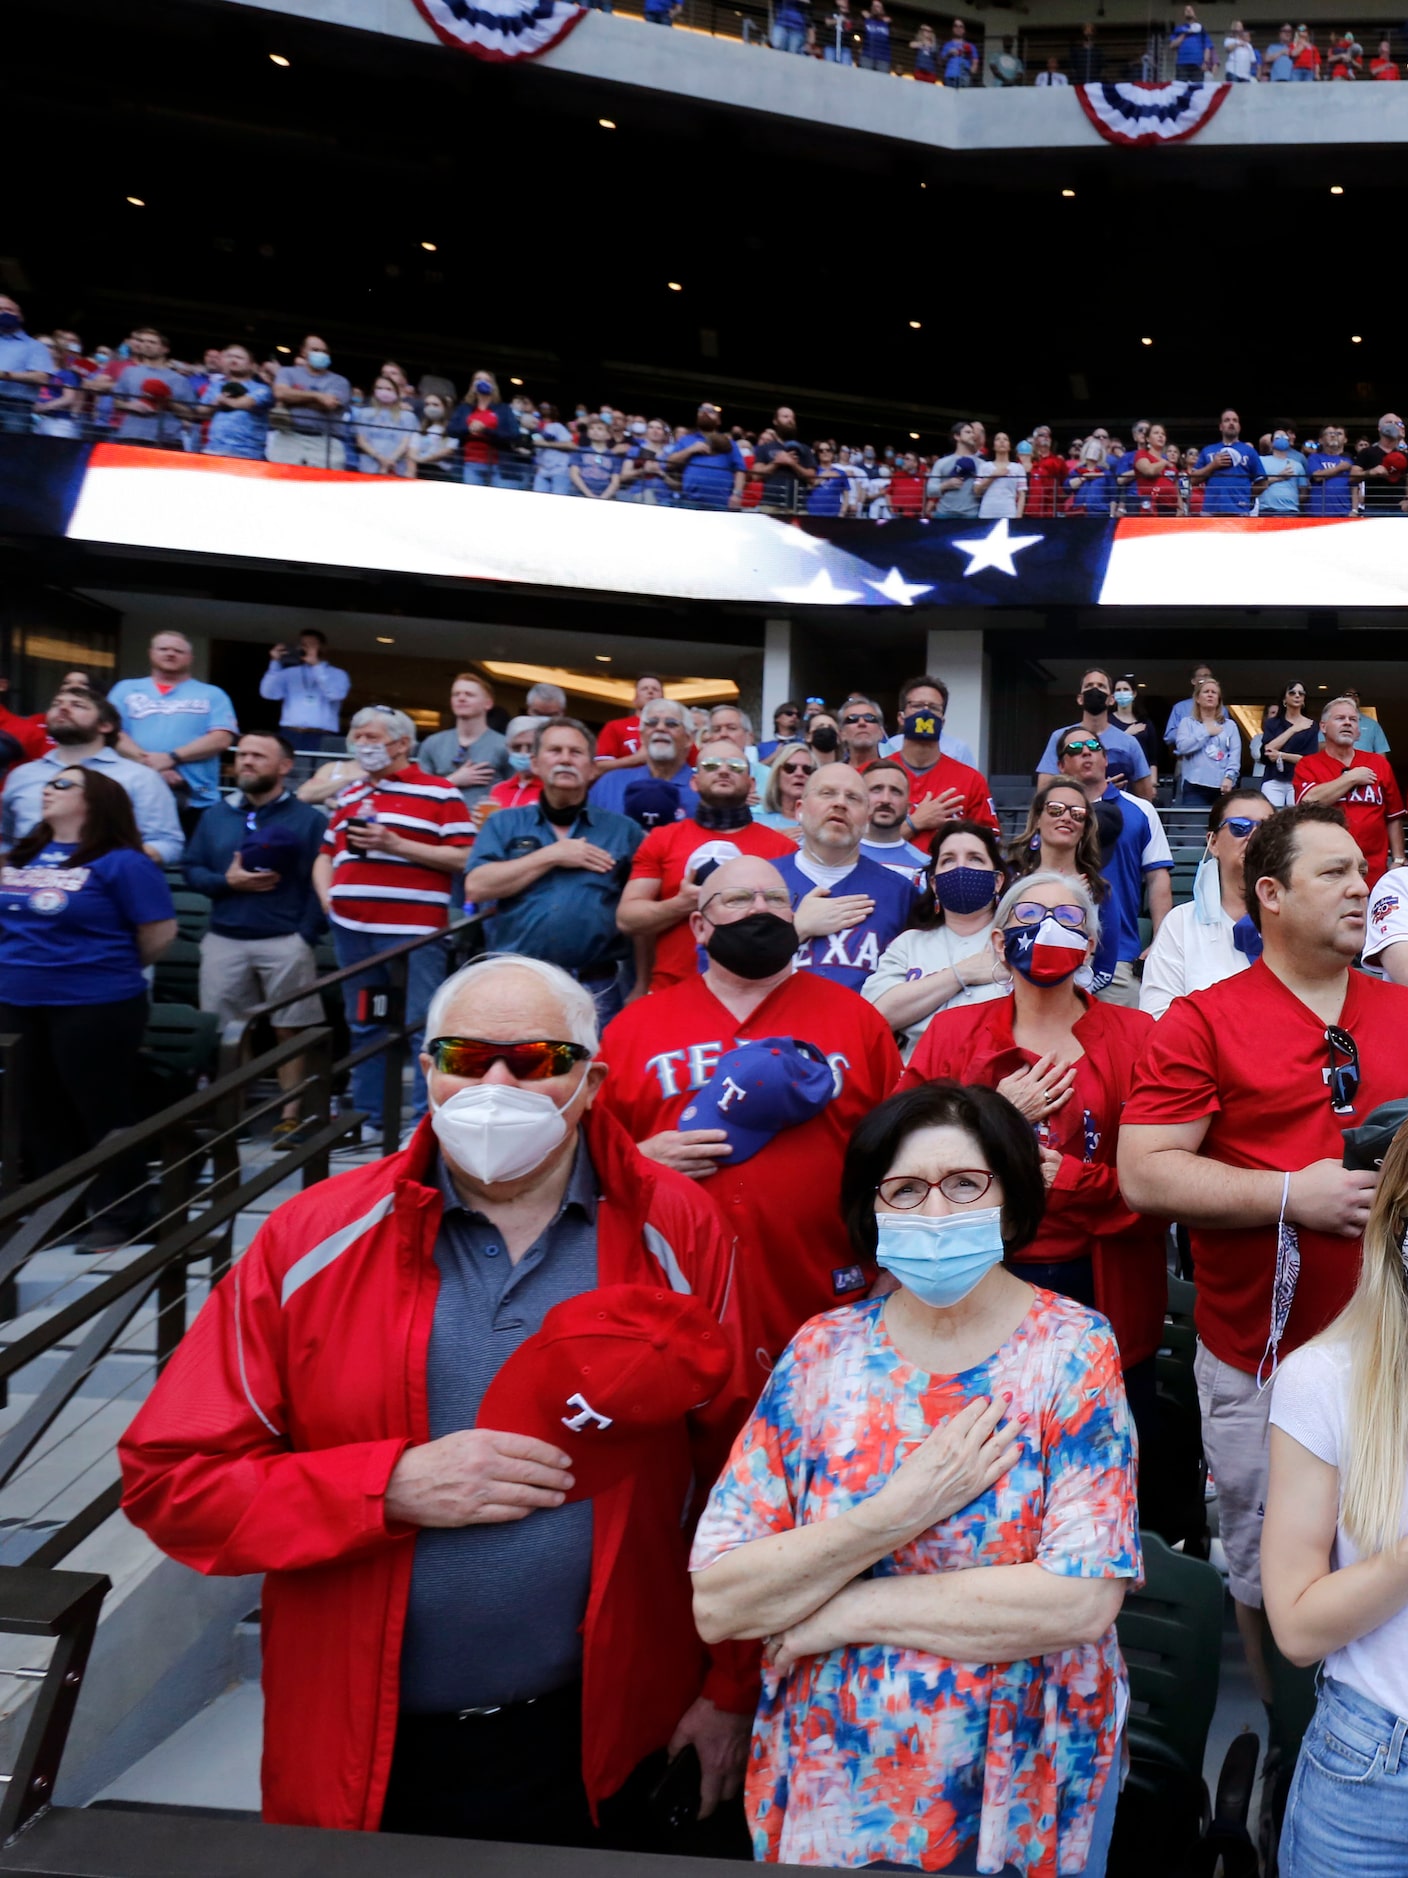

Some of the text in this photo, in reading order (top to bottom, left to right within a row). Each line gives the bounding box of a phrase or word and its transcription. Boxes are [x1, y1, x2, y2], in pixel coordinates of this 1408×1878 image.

[915, 717, 936, 734] M
[642, 811, 660, 825] T
[372, 994, 388, 1017] 10
[717, 1076, 748, 1112] T
[561, 1391, 614, 1433] T
